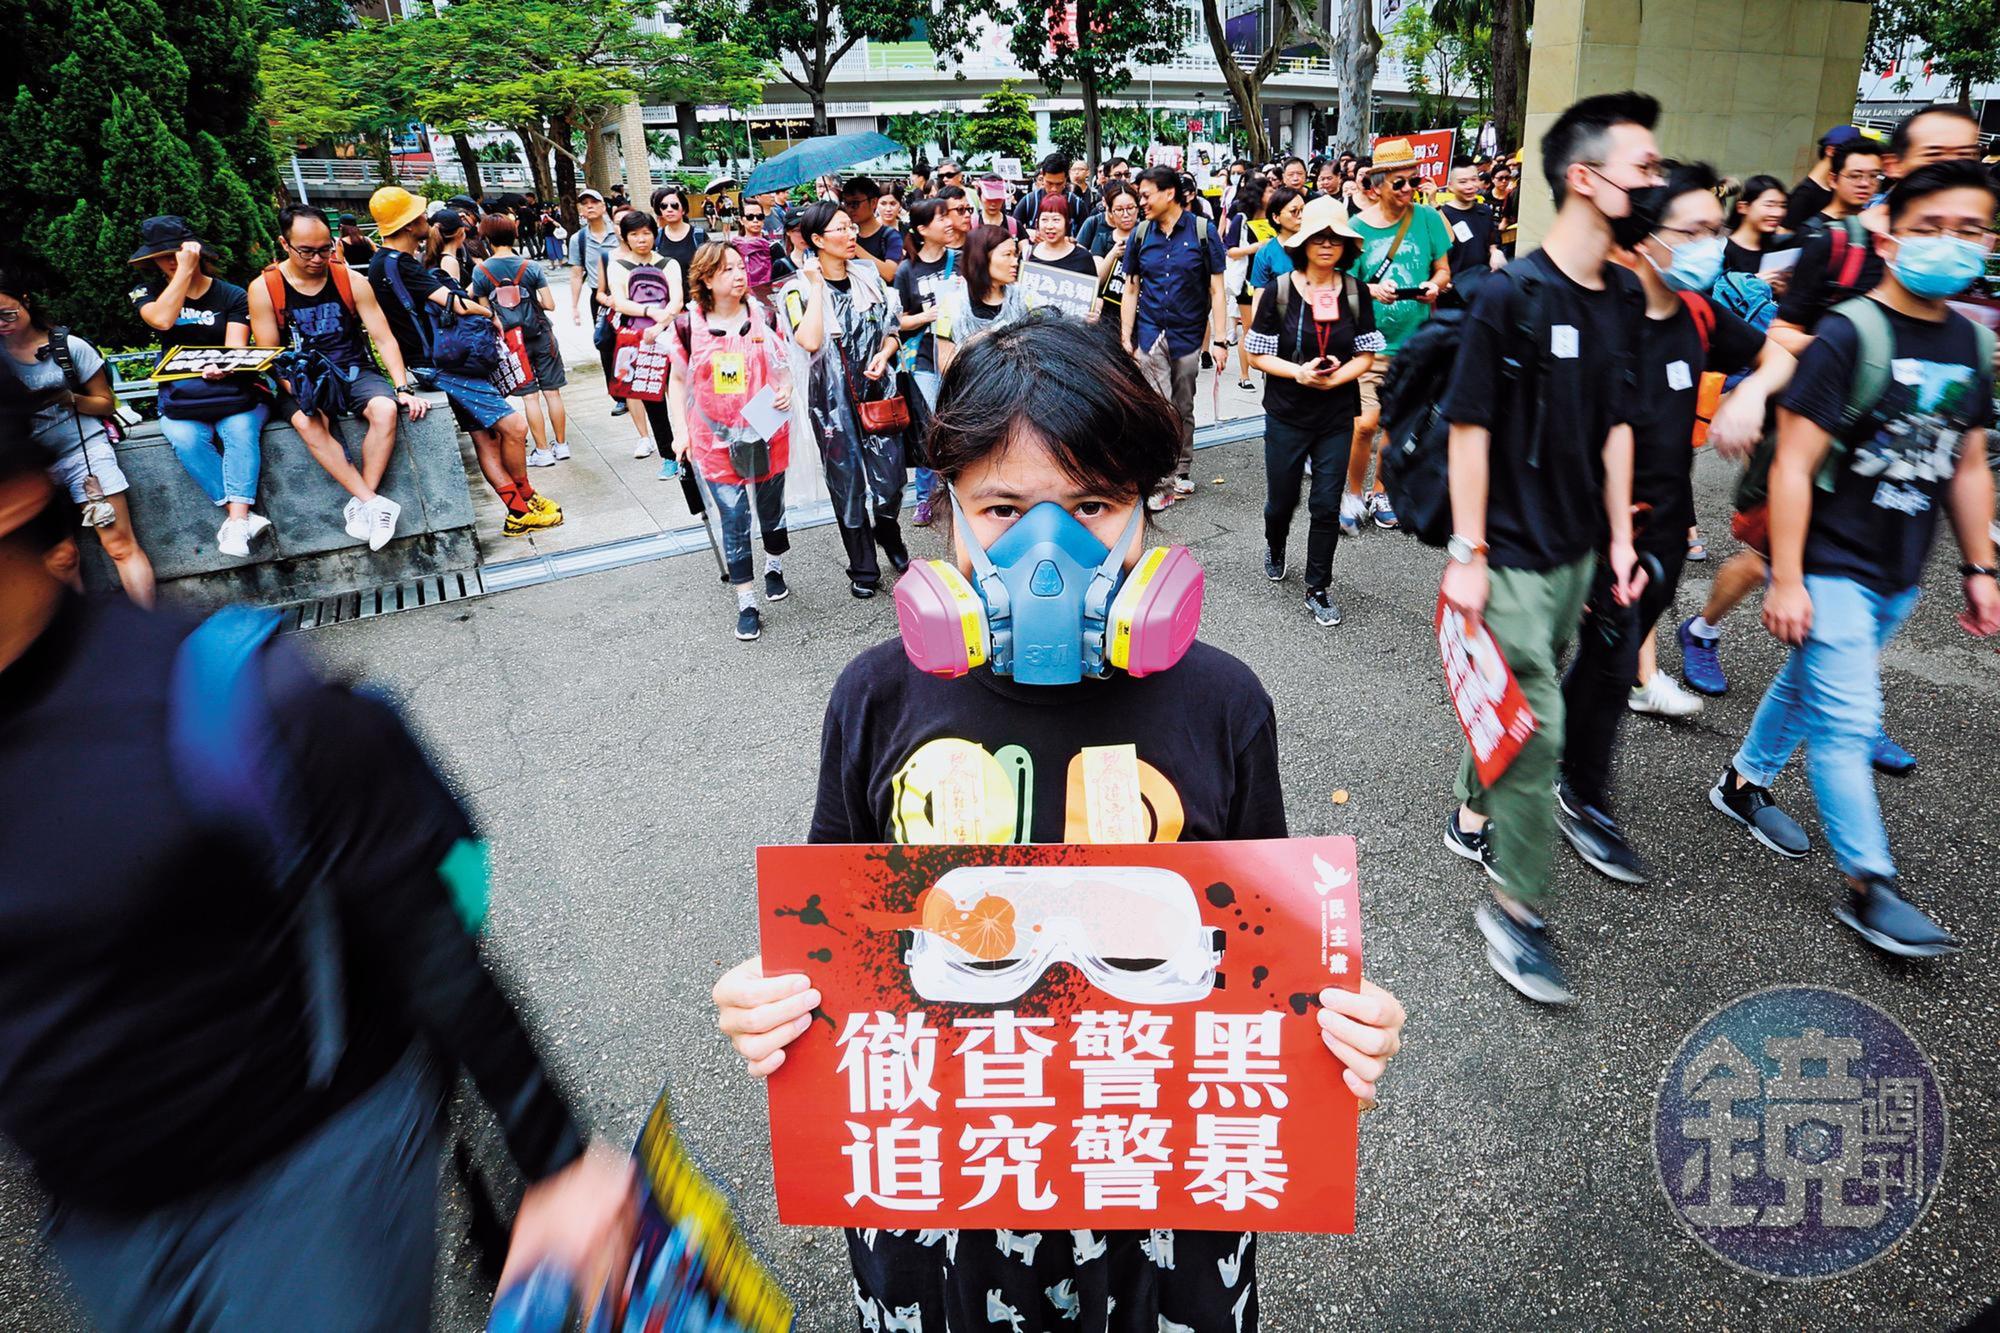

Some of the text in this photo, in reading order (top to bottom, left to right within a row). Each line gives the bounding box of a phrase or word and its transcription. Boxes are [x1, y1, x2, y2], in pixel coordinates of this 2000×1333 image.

[292, 302, 342, 323] NEVER
[1024, 644, 1069, 667] 3M
[835, 1009, 1290, 1114] 徹查警黑
[841, 1113, 1290, 1212] 追究警暴
